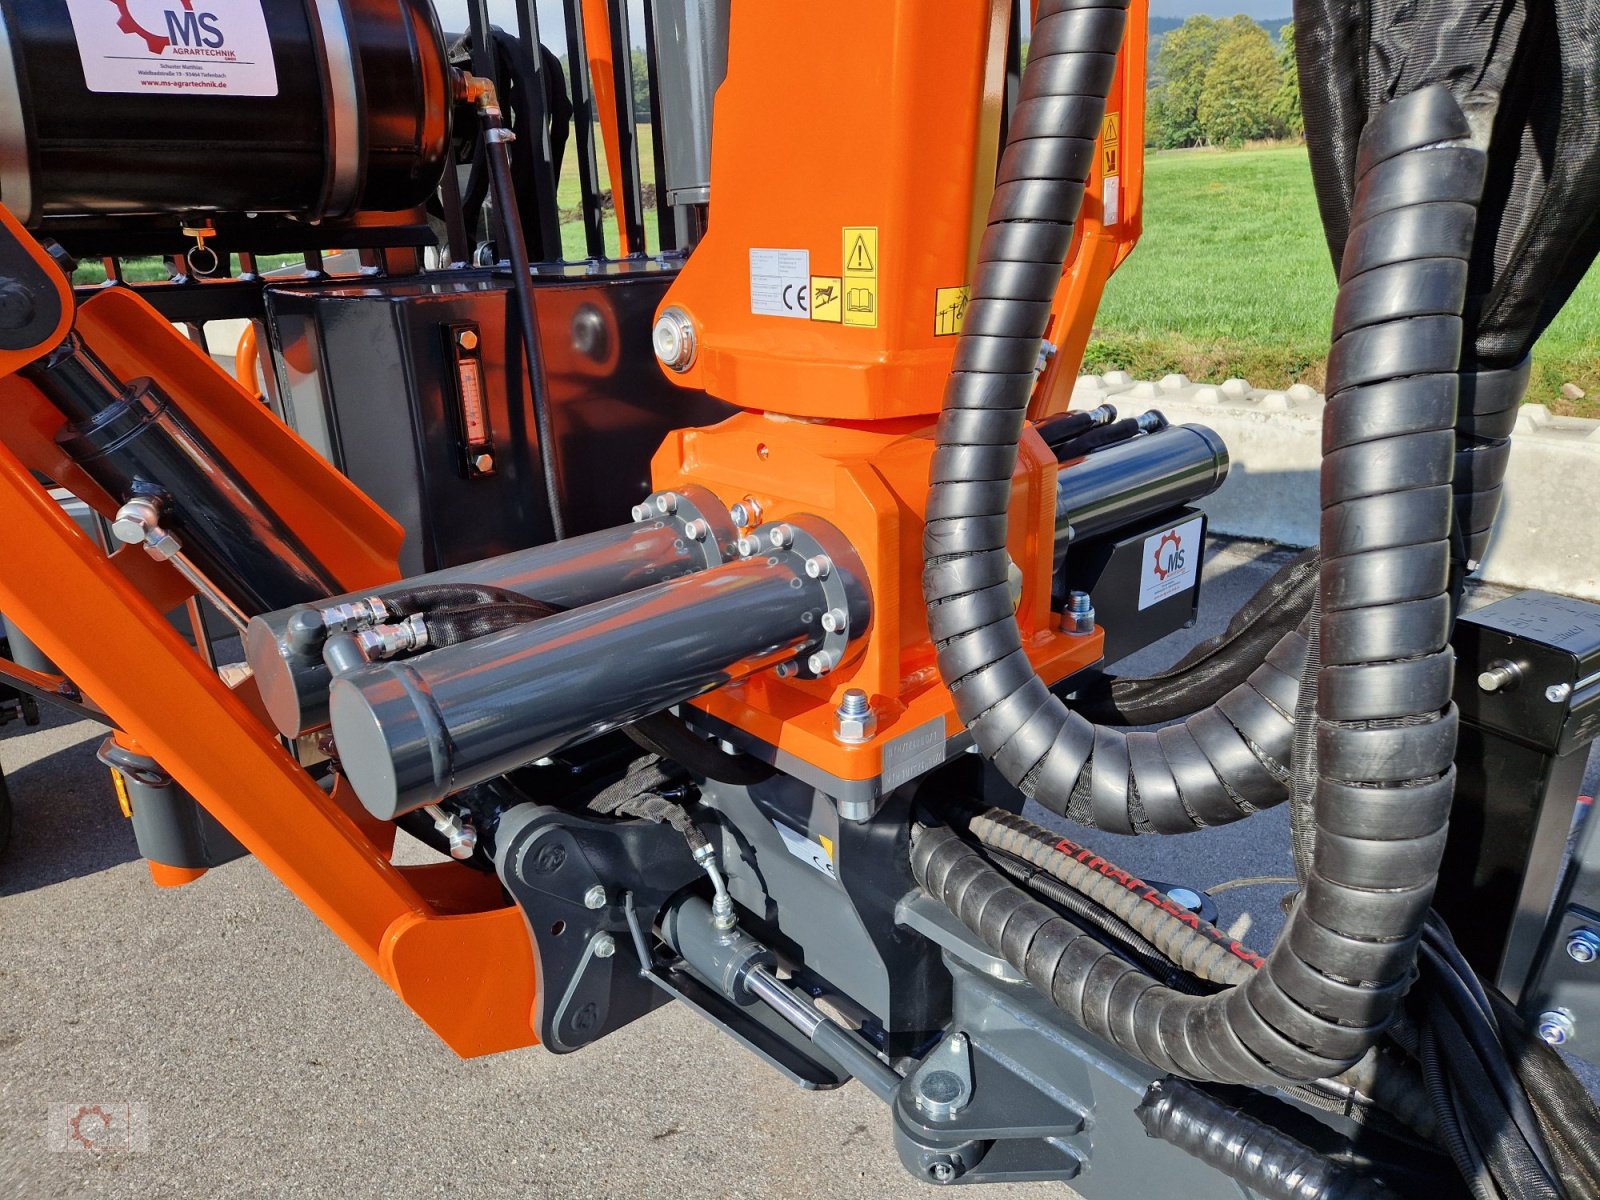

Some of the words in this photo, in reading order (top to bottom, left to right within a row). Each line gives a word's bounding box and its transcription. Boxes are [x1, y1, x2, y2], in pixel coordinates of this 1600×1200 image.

[164, 10, 224, 48] MS
[173, 48, 235, 57] AGRARTECHNIK
[141, 80, 227, 89] www.ms-agrartechnik.de
[1168, 549, 1185, 573] MS
